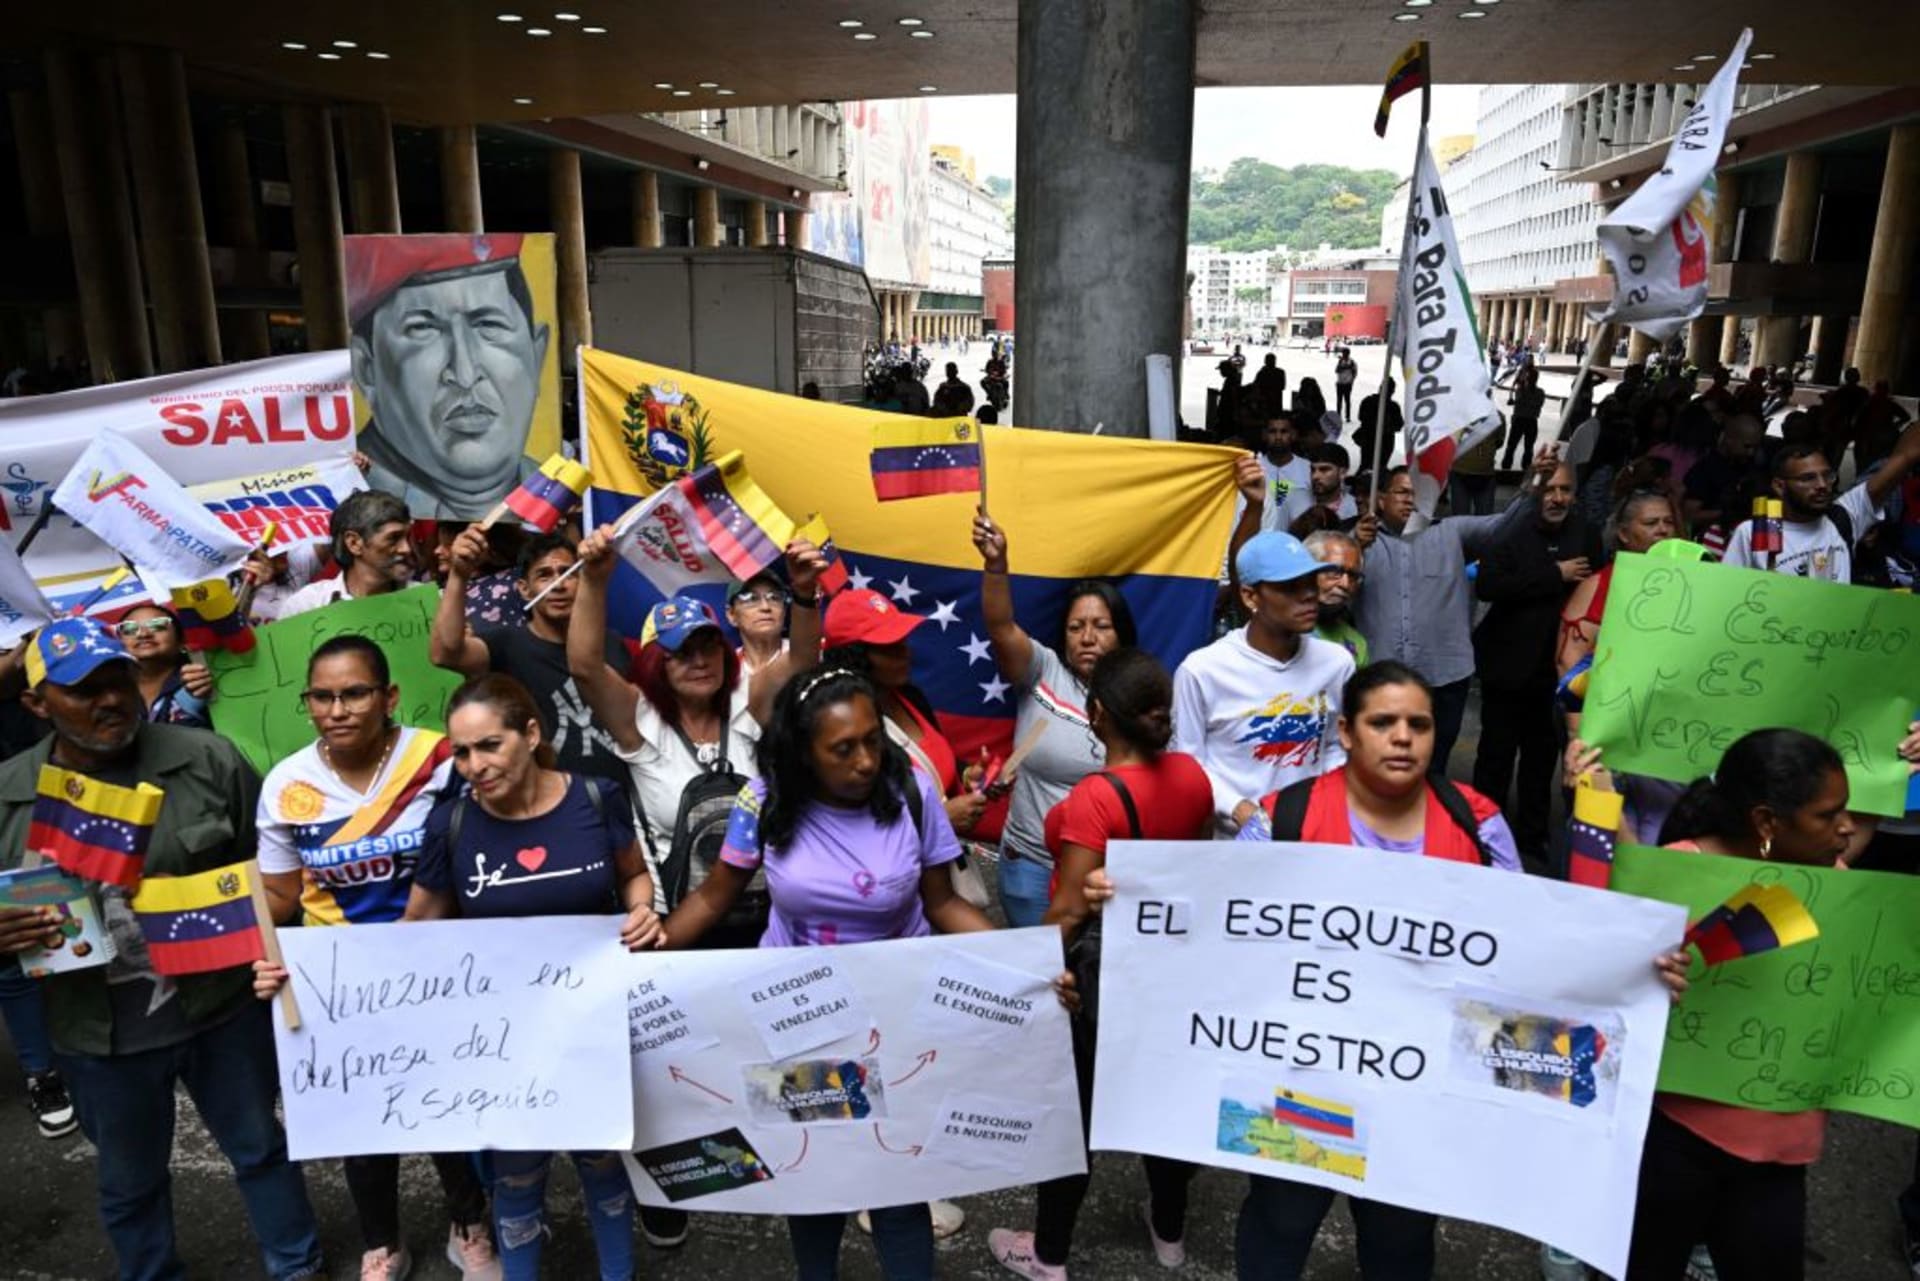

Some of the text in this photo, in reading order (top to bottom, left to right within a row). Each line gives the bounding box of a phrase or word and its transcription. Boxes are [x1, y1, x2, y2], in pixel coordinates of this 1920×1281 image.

[1409, 328, 1457, 449] Todos
[158, 396, 351, 446] SALU
[652, 503, 704, 573] SALUD
[301, 832, 390, 866] OMITÉS
[1138, 900, 1499, 967] EL ESEQUIBO
[296, 940, 584, 1023] Venezuela en
[638, 979, 657, 996] DE
[751, 965, 833, 1004] EL ESEQUIBO
[937, 976, 1034, 1013] DEFENDAMOS
[1292, 962, 1352, 1003] ES
[770, 997, 850, 1033] VENEZUELA!
[792, 994, 811, 1008] ES
[933, 993, 1025, 1027] EL ESEQUIBO!
[452, 1017, 512, 1062] del
[642, 1015, 671, 1032] POR
[669, 1009, 688, 1022] EL
[1190, 1012, 1427, 1082] NUESTRO
[943, 1124, 1028, 1144] ES NUESTRO!
[949, 1110, 1033, 1131] EL ESEQUIBO
